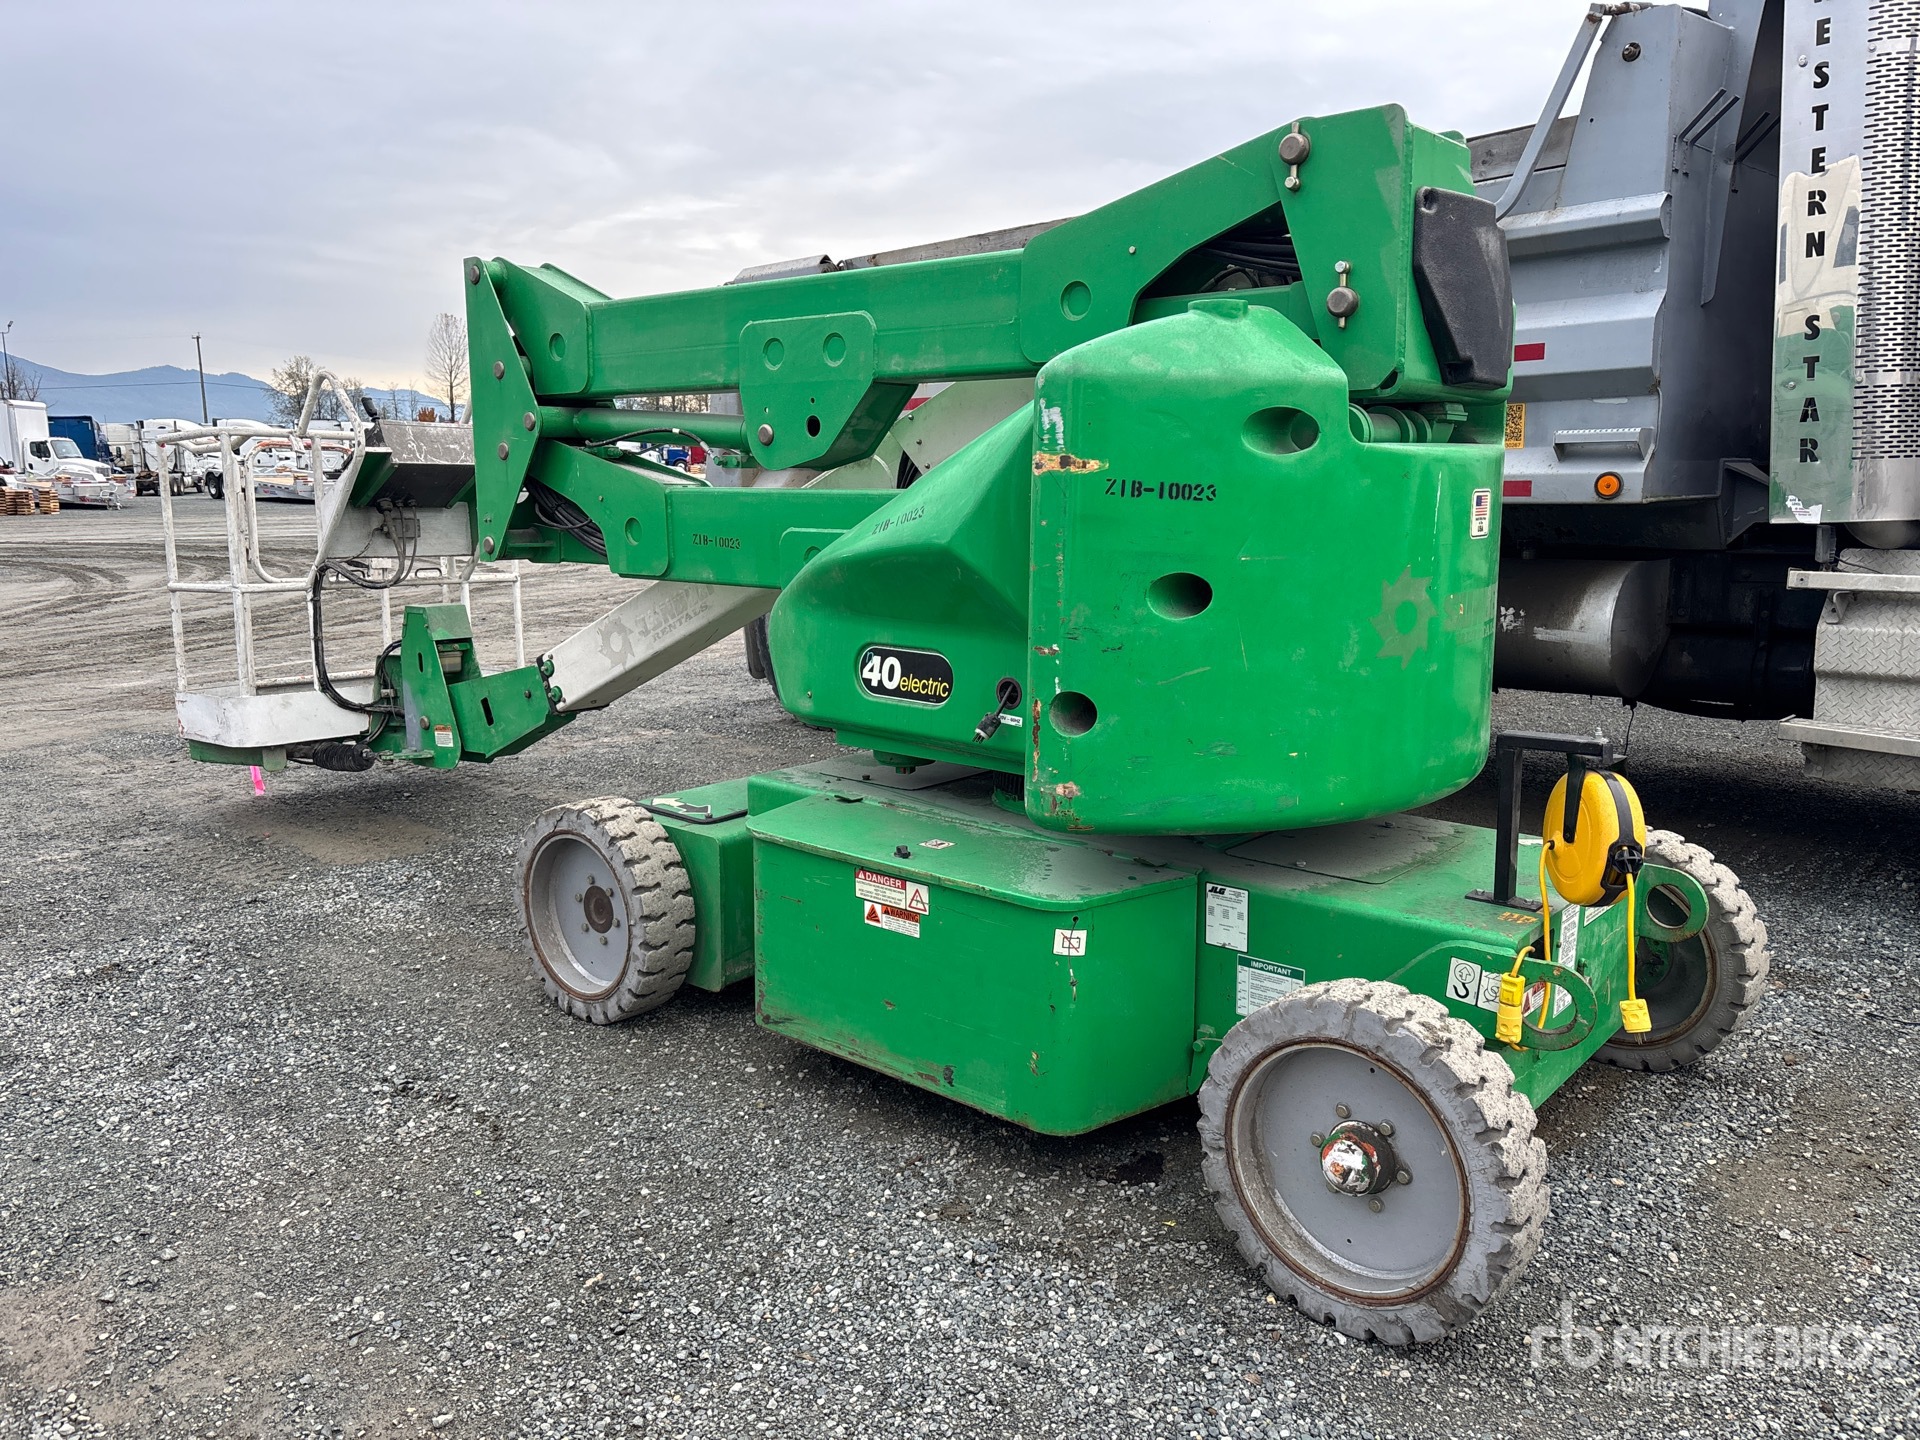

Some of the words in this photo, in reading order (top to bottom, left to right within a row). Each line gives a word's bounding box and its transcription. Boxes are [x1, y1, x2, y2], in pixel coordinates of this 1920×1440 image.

[1805, 0, 1831, 258] ESTERN
[1799, 315, 1820, 463] STAR
[865, 872, 902, 889] DANGER
[1208, 885, 1226, 895] JLG
[889, 909, 919, 923] WARNING
[1250, 960, 1292, 976] IMPORTANT
